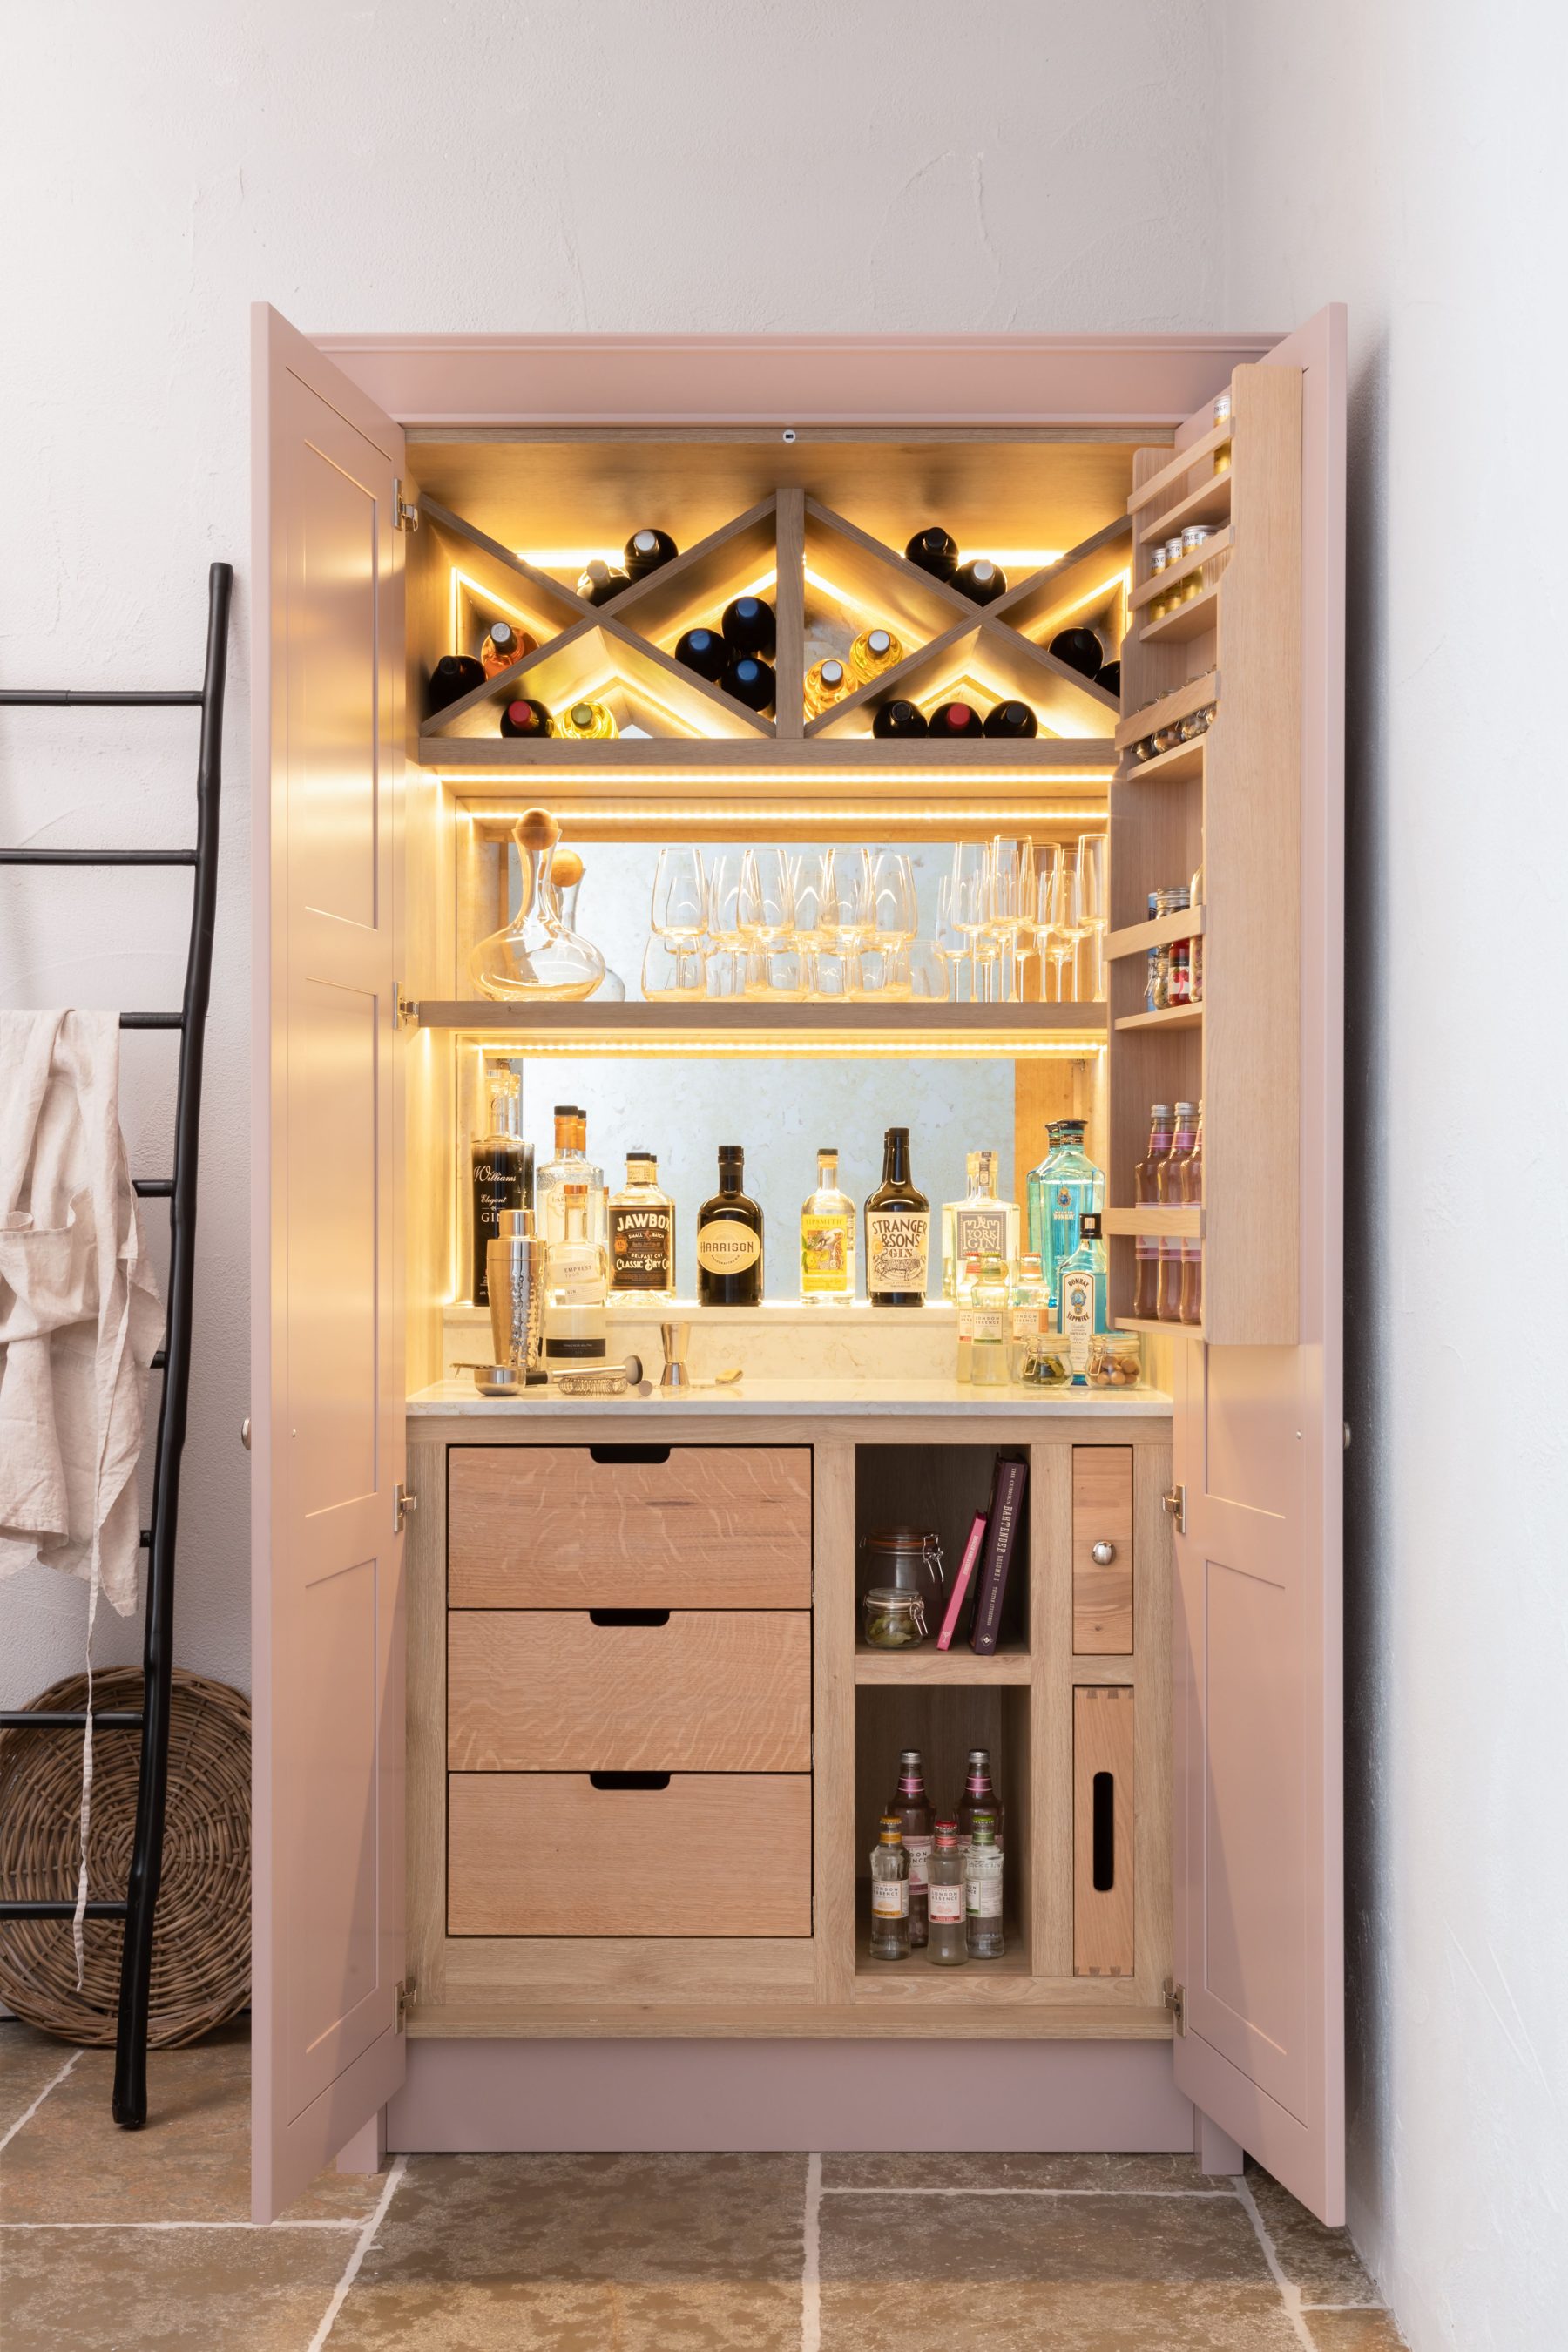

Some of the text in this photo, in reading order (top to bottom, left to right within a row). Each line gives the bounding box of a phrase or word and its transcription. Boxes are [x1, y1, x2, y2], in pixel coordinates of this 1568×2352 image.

[474, 1166, 517, 1182] Williams
[480, 1193, 507, 1206] Elegant
[617, 1213, 670, 1232] JAWBOX
[872, 1219, 927, 1235] STRANGER
[882, 1233, 921, 1247] &SONS
[967, 1230, 997, 1240] YORK
[700, 1241, 754, 1253] HARRISON
[967, 1238, 995, 1248] GIN
[889, 1248, 913, 1258] GIN
[1068, 1278, 1089, 1288] BOMBAY
[1067, 1312, 1089, 1321] SAPPHIRE
[997, 1505, 1013, 1553] BARTENDER
[994, 1555, 1004, 1577] VOLUME
